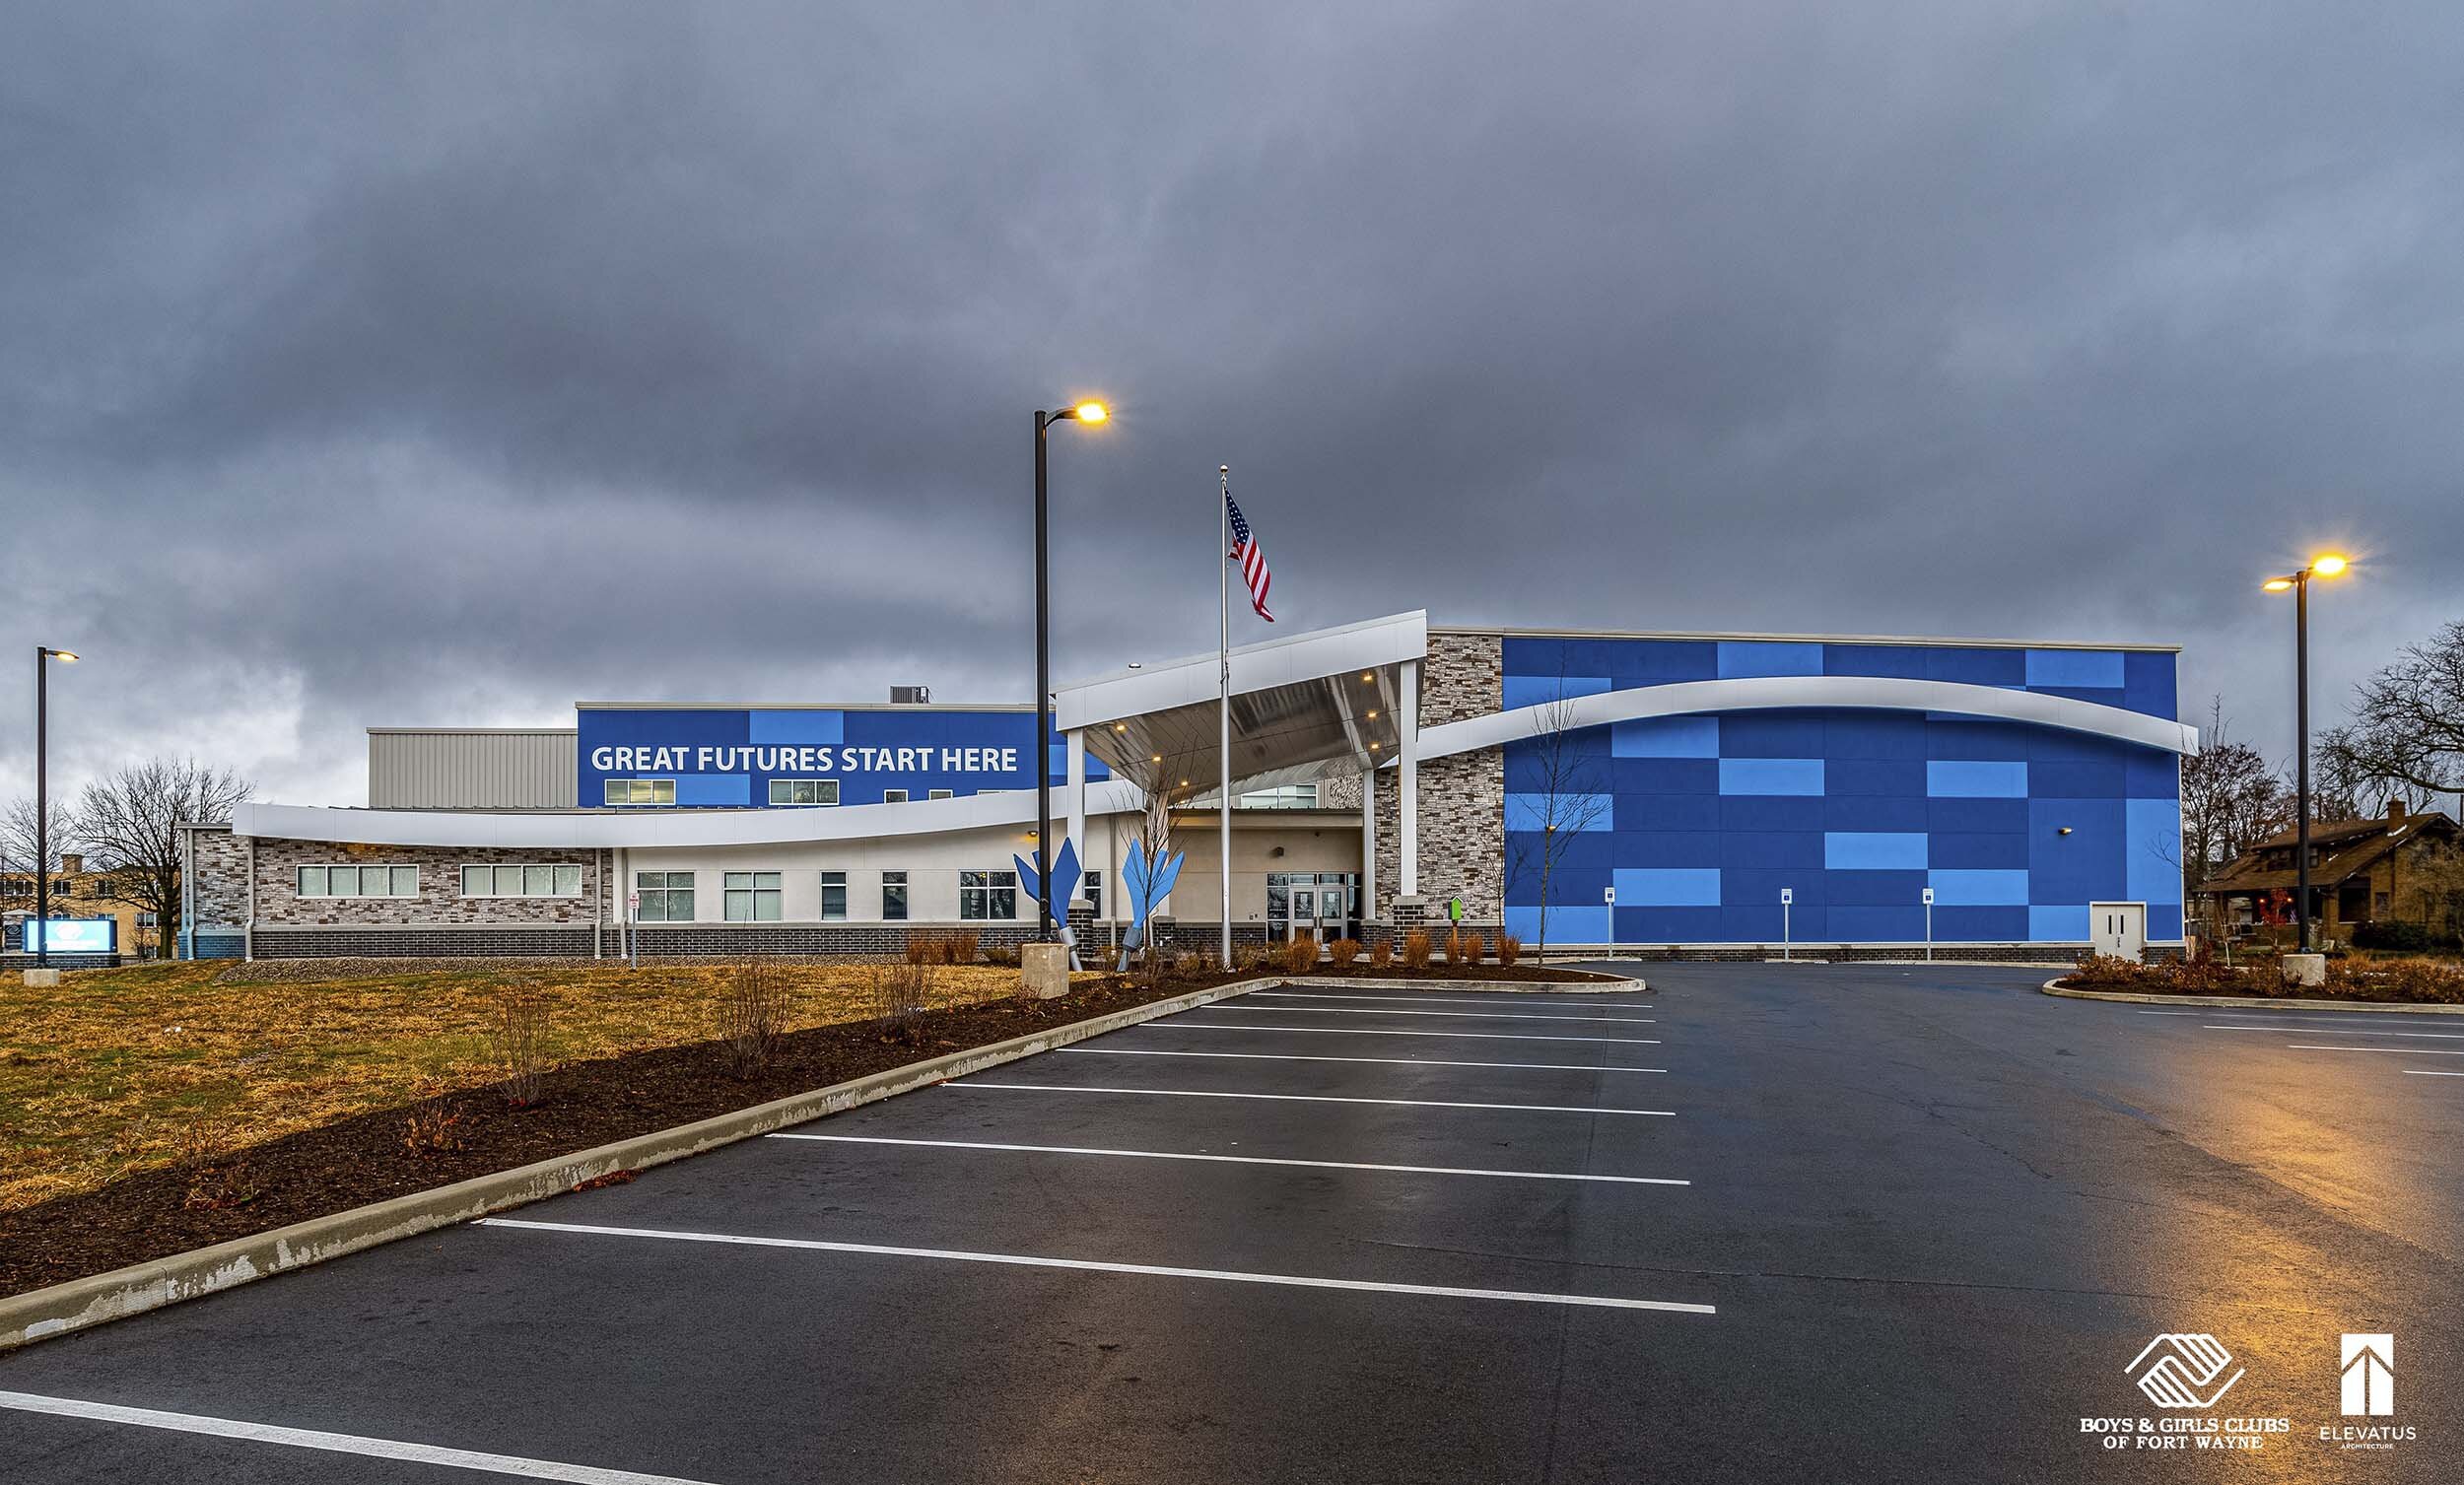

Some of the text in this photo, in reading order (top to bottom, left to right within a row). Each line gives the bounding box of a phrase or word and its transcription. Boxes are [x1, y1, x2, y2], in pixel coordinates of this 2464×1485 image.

[591, 746, 1017, 772] GREAT FUTURES START HERE
